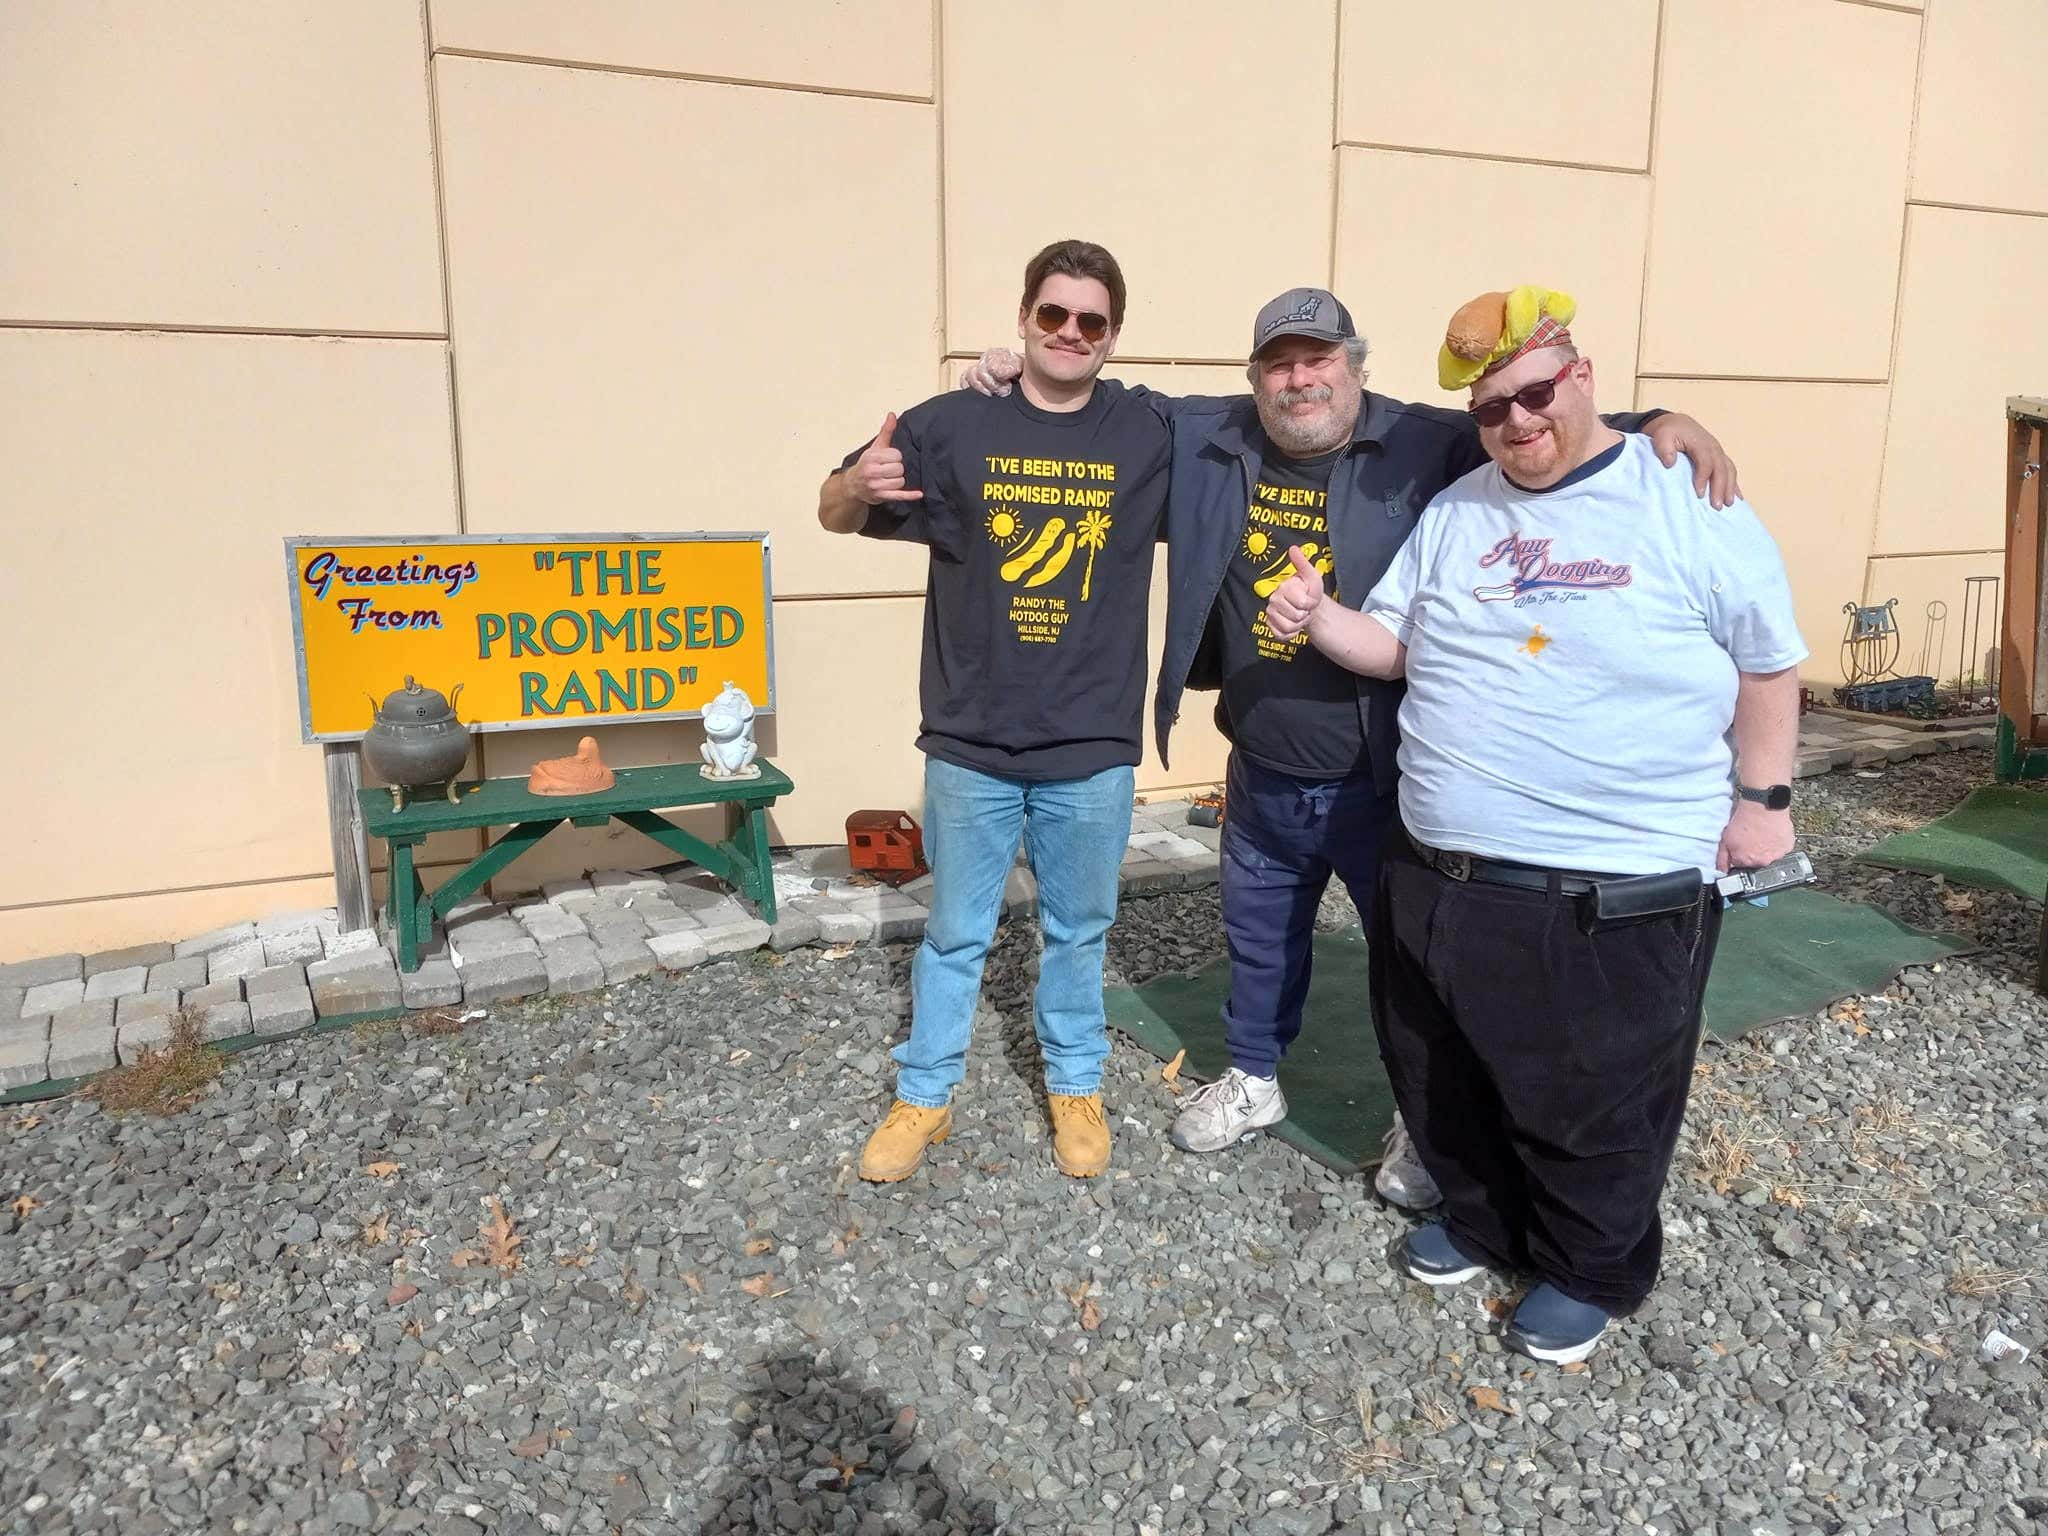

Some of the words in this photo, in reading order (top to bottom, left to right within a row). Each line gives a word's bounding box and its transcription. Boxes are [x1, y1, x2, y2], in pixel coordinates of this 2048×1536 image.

[1264, 314, 1314, 334] MACK
[1022, 458, 1062, 478] BEEN
[1065, 461, 1086, 479] TO
[1088, 463, 1115, 481] THE
[983, 483, 1061, 505] PROMISED
[1279, 488, 1315, 507] BEEN
[304, 552, 479, 598] Greetings
[534, 551, 665, 597] "THE
[1513, 554, 1632, 586] Dogging
[1013, 596, 1047, 609] RANDY
[1048, 599, 1065, 610] THE
[337, 597, 443, 634] From
[1009, 610, 1049, 623] HOTDOG
[1051, 613, 1069, 625] GUY
[477, 605, 745, 660] PROMISED
[1051, 627, 1060, 635] NJ
[520, 666, 699, 716] RAND"
